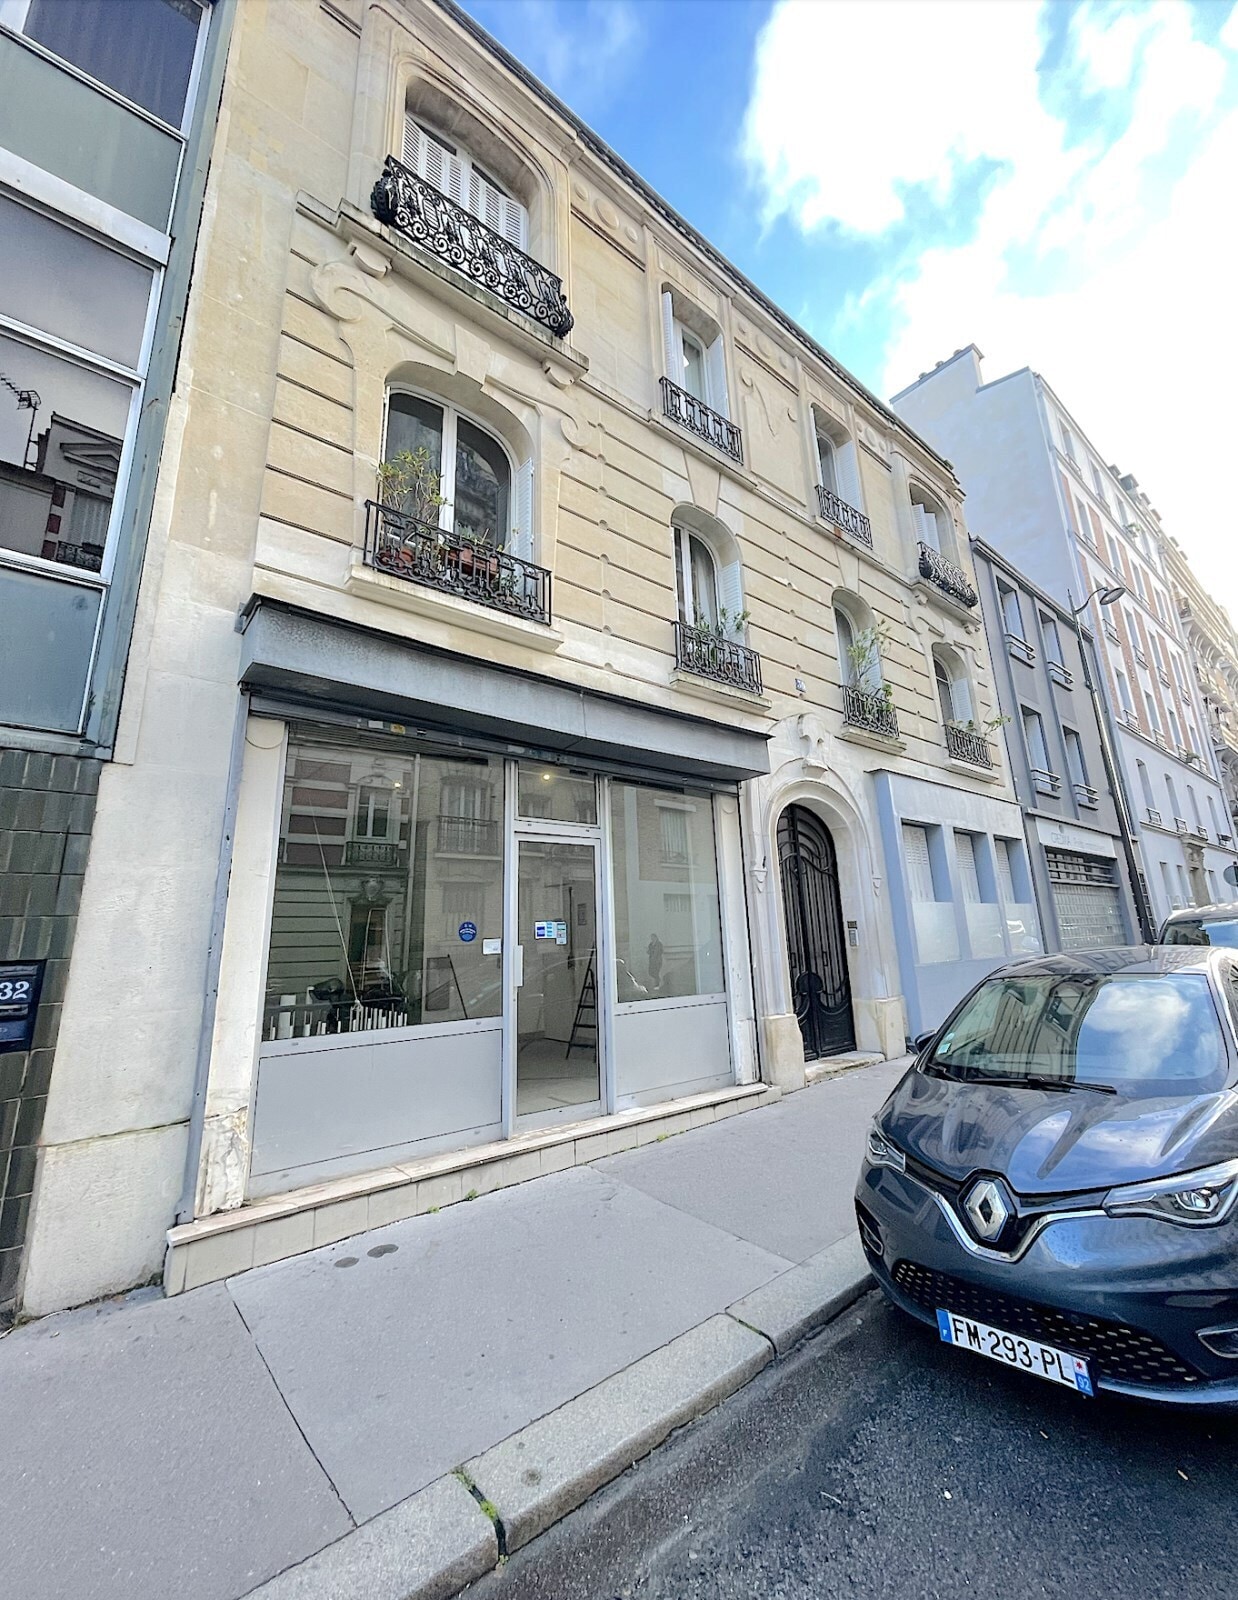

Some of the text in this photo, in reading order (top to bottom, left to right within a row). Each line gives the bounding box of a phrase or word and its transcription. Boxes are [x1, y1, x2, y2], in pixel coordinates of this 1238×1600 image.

[0, 981, 30, 1000] 32
[952, 1317, 1075, 1385] FM-293-PL
[1077, 1375, 1091, 1391] 92
